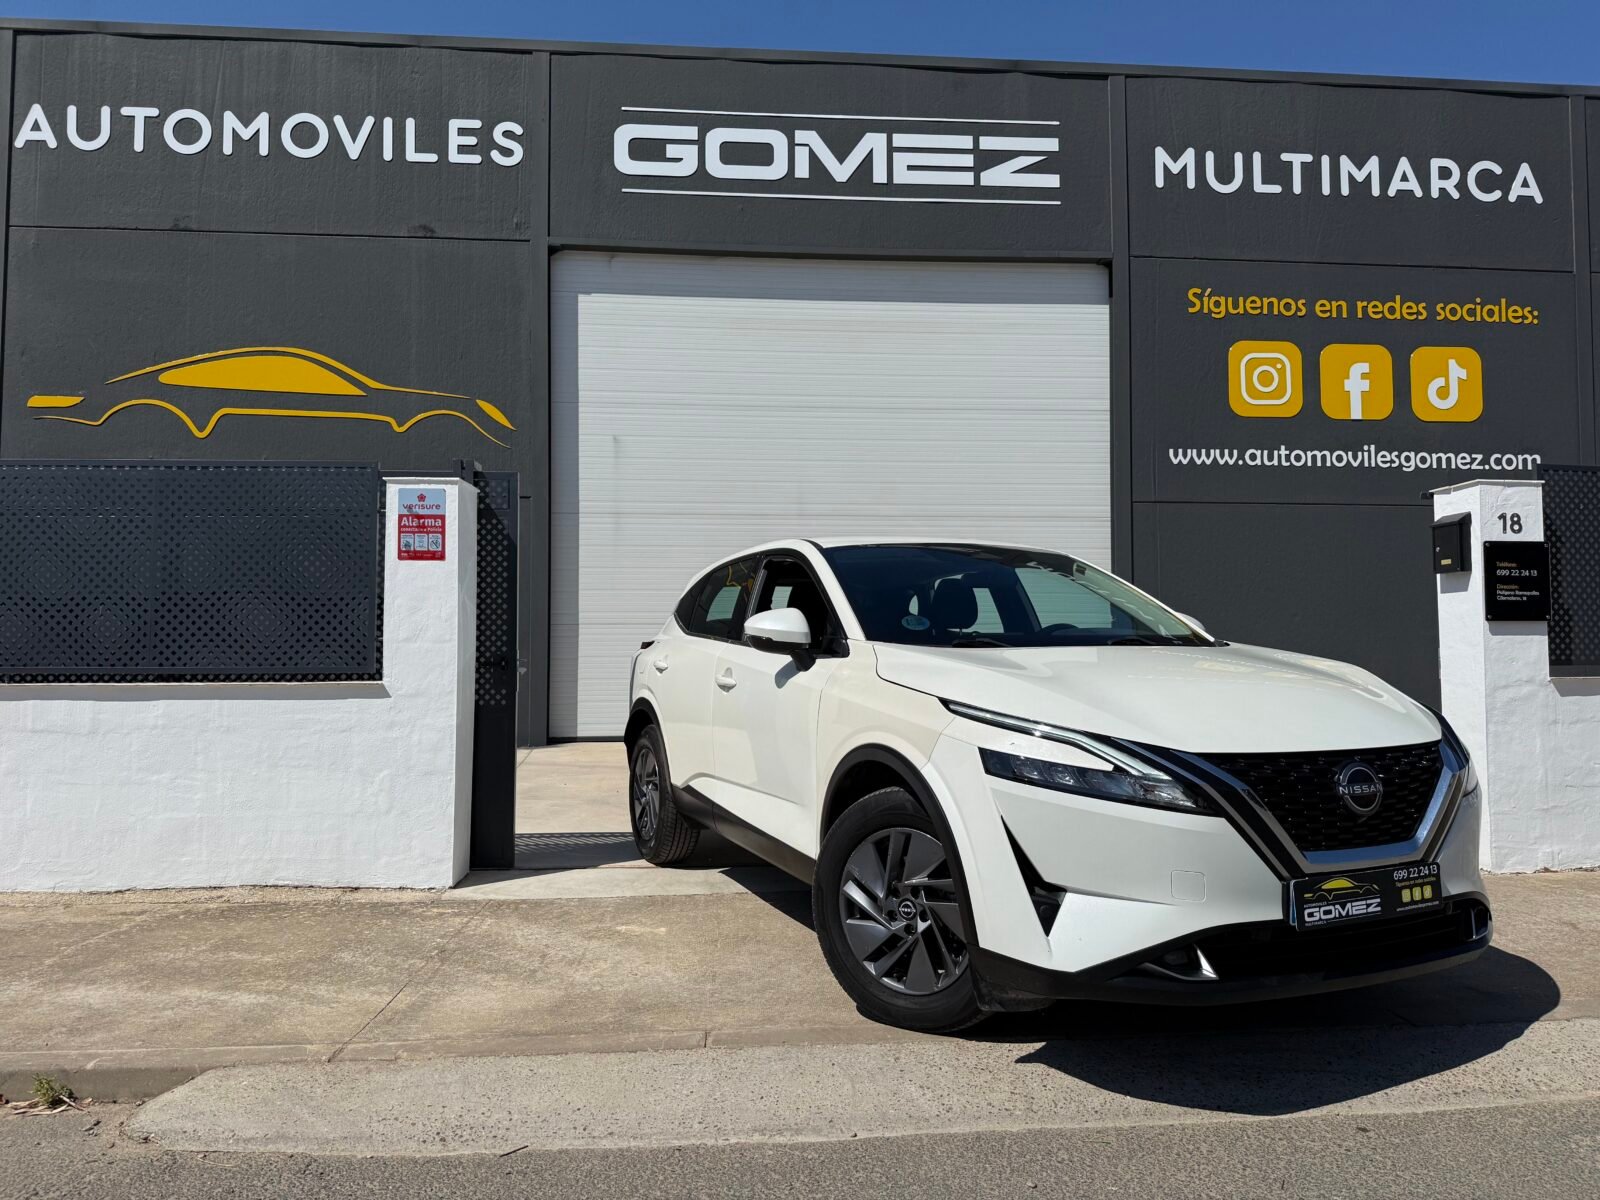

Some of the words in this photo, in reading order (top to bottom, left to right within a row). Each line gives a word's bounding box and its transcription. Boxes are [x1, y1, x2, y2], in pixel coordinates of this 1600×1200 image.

[14, 103, 524, 167] AUTOMOVILES
[613, 123, 1061, 188] GOMEZ
[1154, 146, 1544, 205] MULTIMARCA
[1187, 287, 1307, 319] Síguenos
[1314, 299, 1348, 318] en
[1356, 295, 1428, 320] redes
[1436, 297, 1538, 325] sociales:
[1168, 444, 1541, 473] www.automovilesgomez.com
[401, 517, 442, 527] Alarma
[1497, 512, 1523, 534] 18
[1520, 569, 1530, 577] 24
[1339, 784, 1383, 795] NISSAN
[1393, 869, 1408, 880] 699
[1408, 867, 1419, 878] 22
[1419, 866, 1429, 876] 24
[1429, 864, 1438, 874] 13
[1303, 898, 1382, 922] GOMEZ
